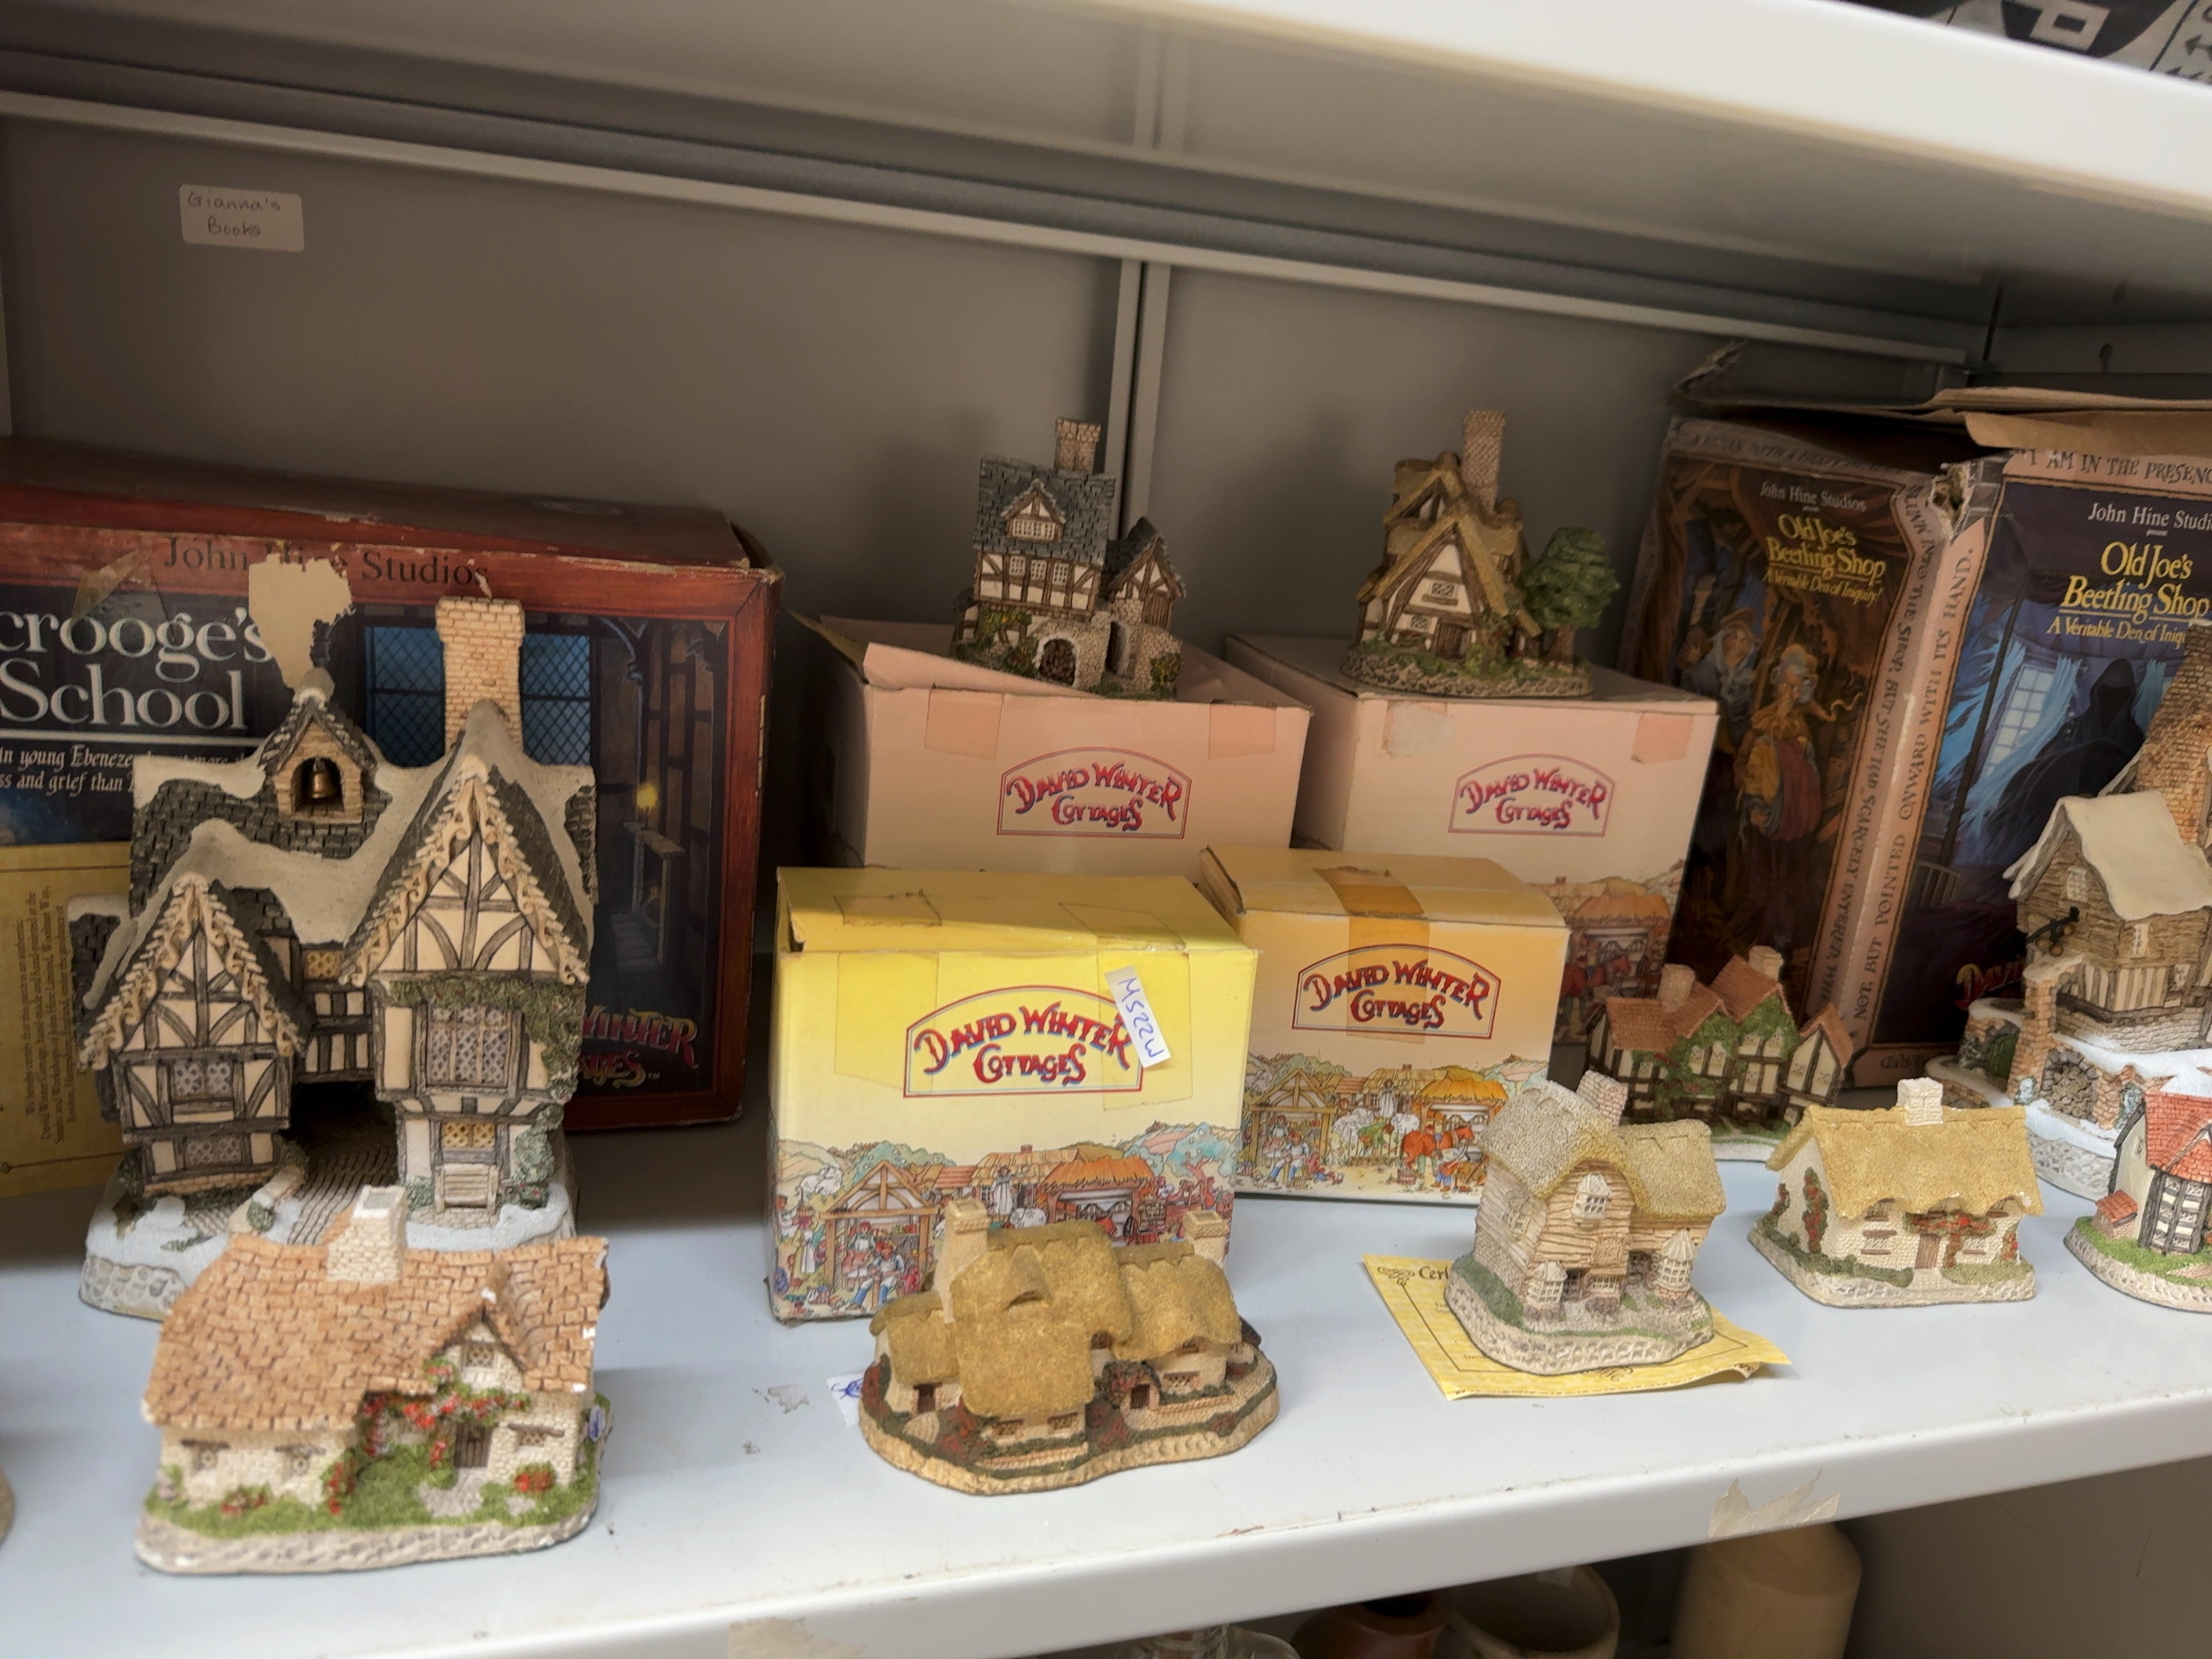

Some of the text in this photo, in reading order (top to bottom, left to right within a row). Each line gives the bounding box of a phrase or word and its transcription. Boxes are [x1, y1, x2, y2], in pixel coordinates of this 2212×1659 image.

[2045, 451, 2075, 470] AM
[2080, 453, 2101, 474] IN
[2107, 457, 2140, 476] THE
[2143, 462, 2212, 485] PRESENC
[1760, 481, 1866, 512] John Hine Studios
[2087, 501, 2212, 531] John Hine Studi
[1778, 514, 1857, 551] Old Joe's
[164, 537, 248, 571] John
[362, 551, 490, 585] Studios
[1766, 536, 1886, 587] Beetling Shop
[2101, 540, 2193, 589] Old Joe's
[1809, 575, 1831, 595] Den
[1830, 581, 1844, 597] of
[1904, 585, 1923, 620] THE
[2060, 575, 2211, 625] Beetling Shop
[0, 607, 275, 683] crooge's
[2045, 616, 2062, 635] A
[2064, 616, 2115, 639] Veritable
[2115, 620, 2142, 640] Den
[2144, 623, 2161, 641] of
[0, 658, 248, 730] School
[1881, 678, 1899, 715] BUT
[1874, 713, 1891, 756] SHE
[18, 749, 66, 773] young
[70, 744, 133, 768] Ebeneze
[1864, 936, 1882, 973] BUT
[1874, 834, 1906, 927] POINTED
[1899, 734, 1927, 821] ONWARD
[1919, 669, 1942, 725] WITH
[1933, 629, 1951, 661] ITS
[1944, 548, 1975, 619] HAND.
[1867, 757, 1883, 788] HAD
[16, 770, 45, 790] and
[46, 771, 88, 798] grief
[90, 772, 123, 792] than
[1006, 760, 1182, 821] DAVID WINTER
[1459, 767, 1607, 820] DAVID WINTER
[1051, 794, 1143, 832] COTTAGES
[1495, 797, 1572, 830] COTTAGES
[1846, 787, 1875, 877] SCARCELY
[1303, 959, 1490, 1021] DAVID WINTER
[1350, 988, 1447, 1030] COTTAGES
[914, 1001, 1131, 1075] DAVID WINTER
[973, 1043, 1087, 1088] COTTAGES
